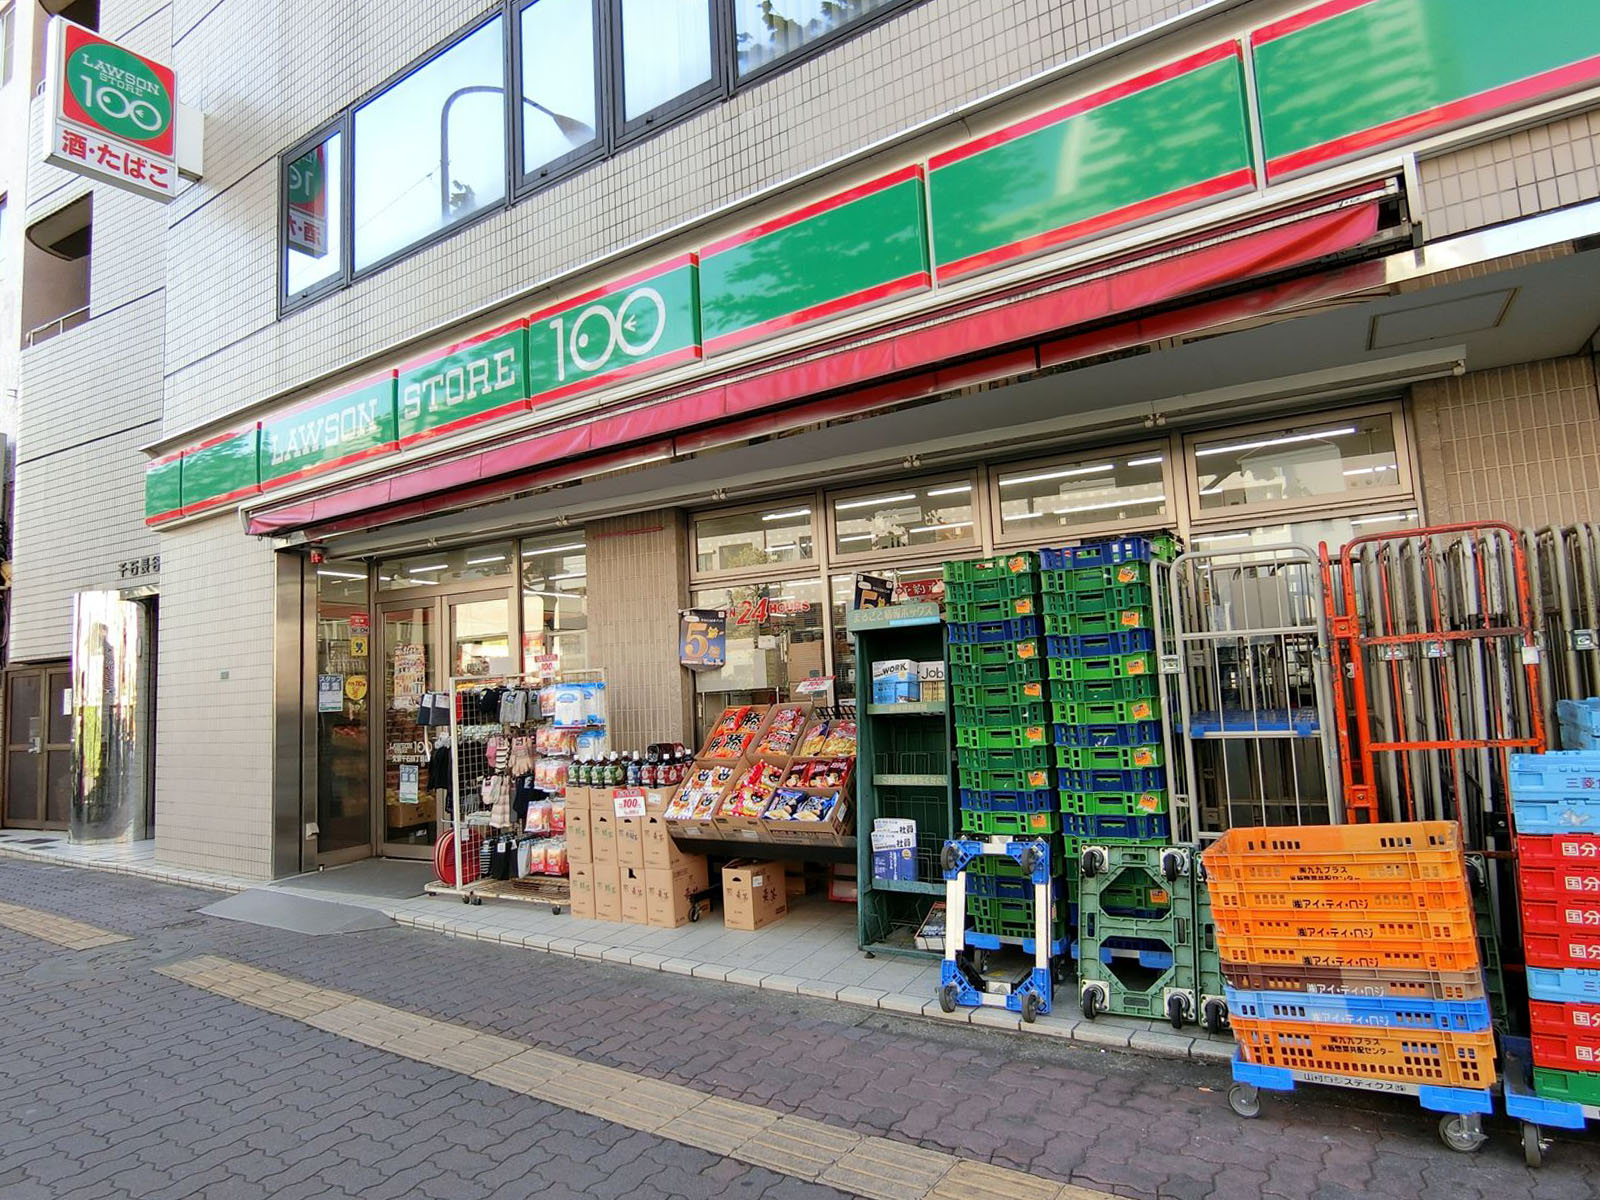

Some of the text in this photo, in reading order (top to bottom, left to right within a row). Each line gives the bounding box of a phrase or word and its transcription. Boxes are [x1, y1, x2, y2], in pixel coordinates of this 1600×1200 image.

[82, 53, 160, 96] LAWSON
[99, 72, 143, 97] STORE
[80, 75, 162, 131] 100
[62, 129, 169, 189] 酒・たばこ
[271, 287, 666, 466] LAWSON STORE 100
[735, 597, 769, 626] 24
[769, 601, 811, 614] HOURS
[882, 663, 907, 675] WORK
[921, 667, 944, 680] Job
